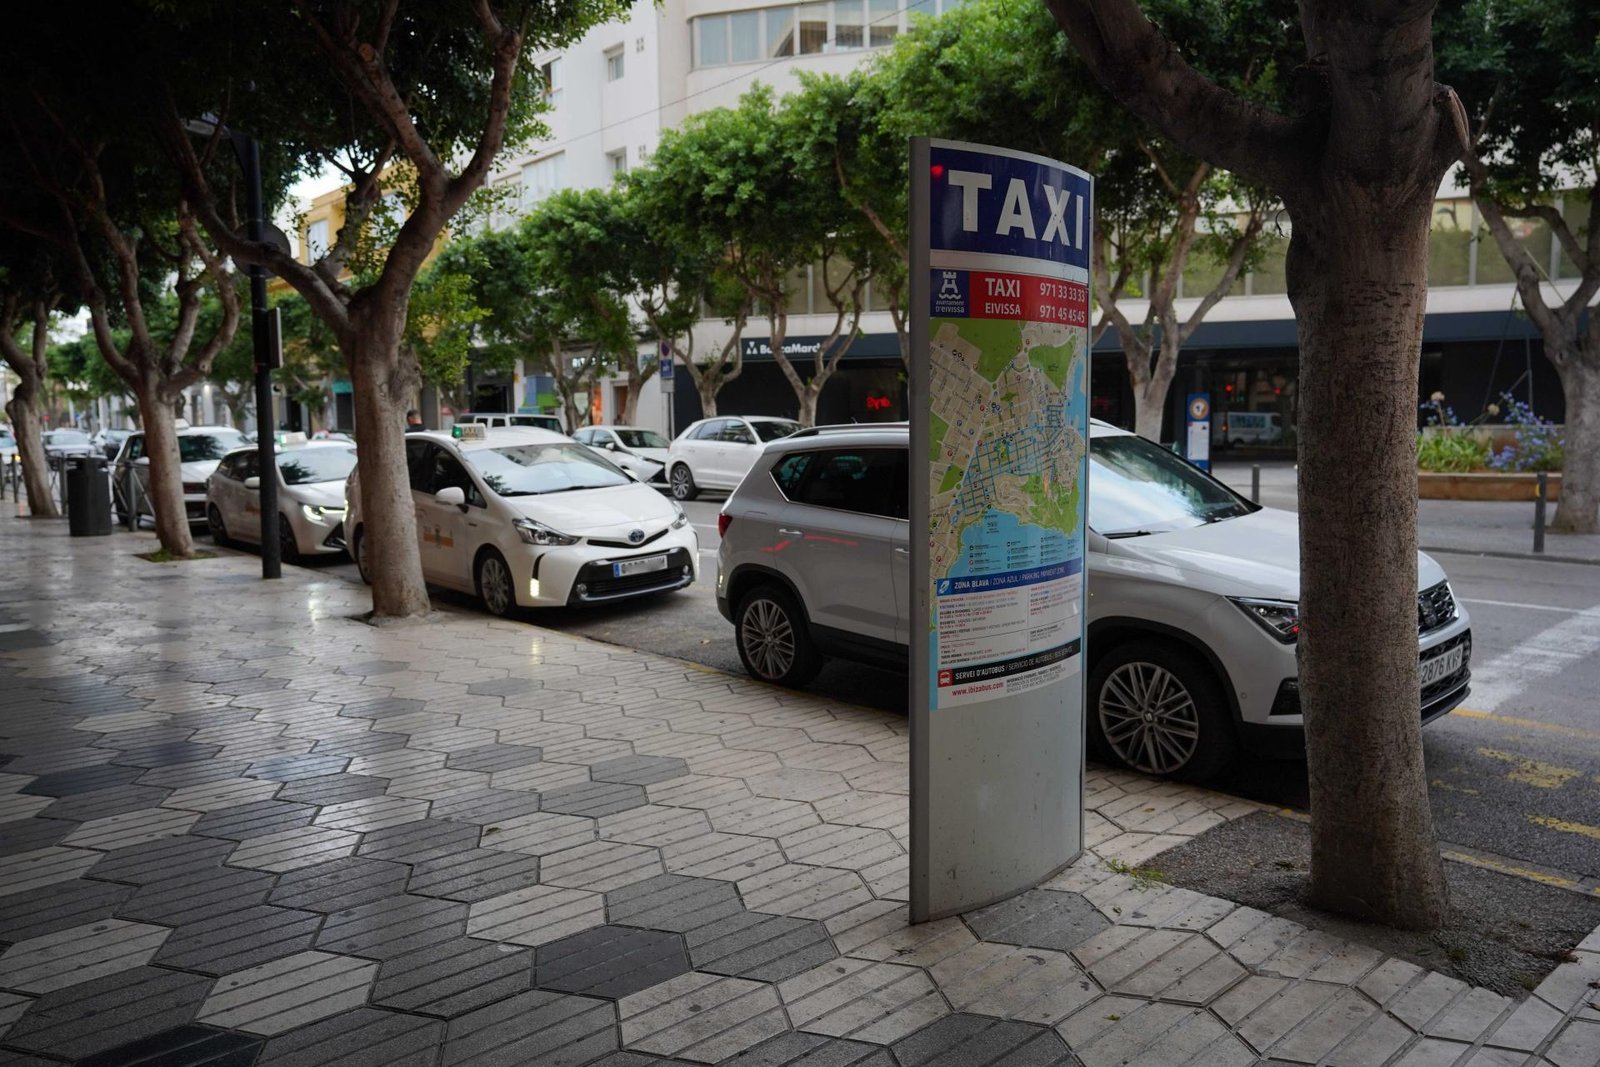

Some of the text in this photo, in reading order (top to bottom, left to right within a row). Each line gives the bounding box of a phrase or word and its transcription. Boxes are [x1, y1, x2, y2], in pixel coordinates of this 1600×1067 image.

[948, 169, 1084, 250] TAXI
[985, 277, 1020, 298] TAXI
[1040, 282, 1085, 302] 971 33 33 33
[985, 302, 1021, 315] EIVISSA
[1040, 304, 1085, 323] 971 45 45 45
[954, 582, 971, 590] ZONA
[972, 580, 990, 588] BLAVA
[955, 671, 975, 680] SERVEI
[976, 665, 1006, 677] D'AUTOBUS
[1421, 657, 1444, 684] 2876
[952, 682, 1004, 697] www.ibizabus.com
